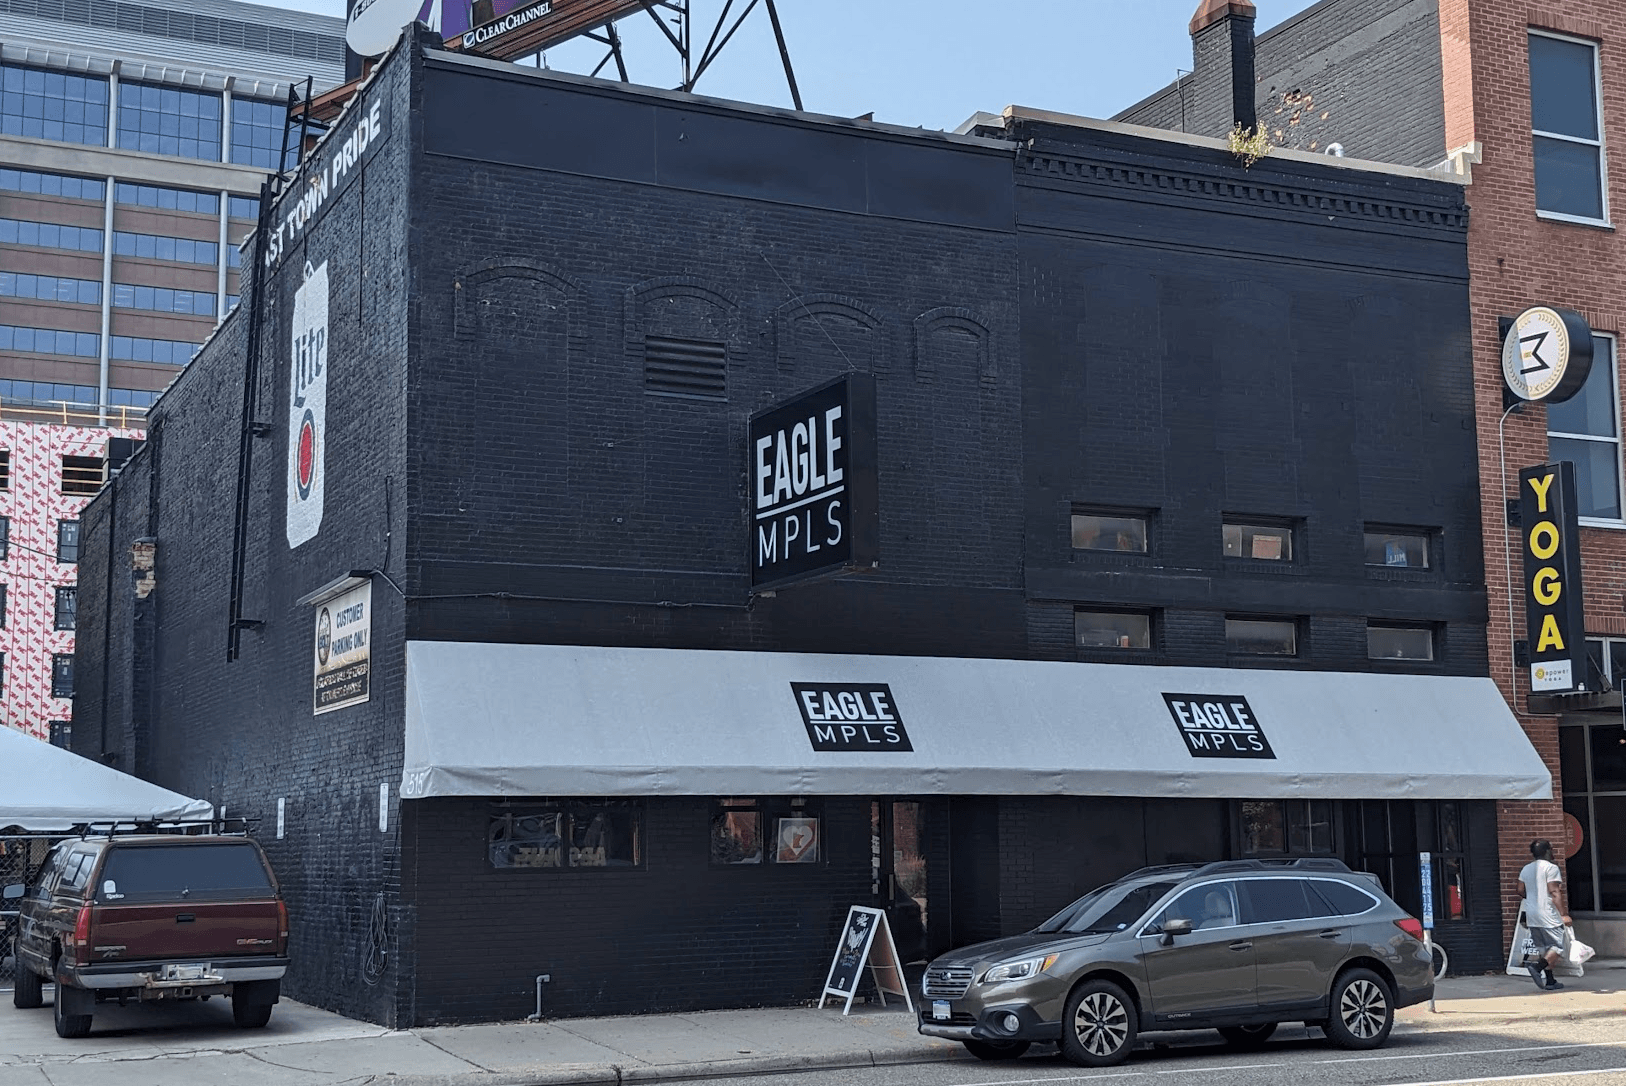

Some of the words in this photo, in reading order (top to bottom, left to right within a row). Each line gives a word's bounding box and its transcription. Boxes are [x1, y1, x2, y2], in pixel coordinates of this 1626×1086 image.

[287, 168, 328, 240] TOWN
[333, 98, 381, 190] PRIDE
[293, 326, 325, 409] Lite
[756, 405, 843, 510] EAGLE
[758, 500, 842, 567] MPLS
[1527, 473, 1566, 653] YOGA
[336, 602, 364, 629] CUSTOMER
[331, 633, 353, 657] PARKING
[354, 627, 368, 649] ONLY
[801, 690, 894, 720] EAGLE
[1171, 701, 1256, 730] EAGLE
[814, 725, 901, 743] MPLS
[1188, 733, 1264, 751] MPLS
[406, 772, 424, 795] 515
